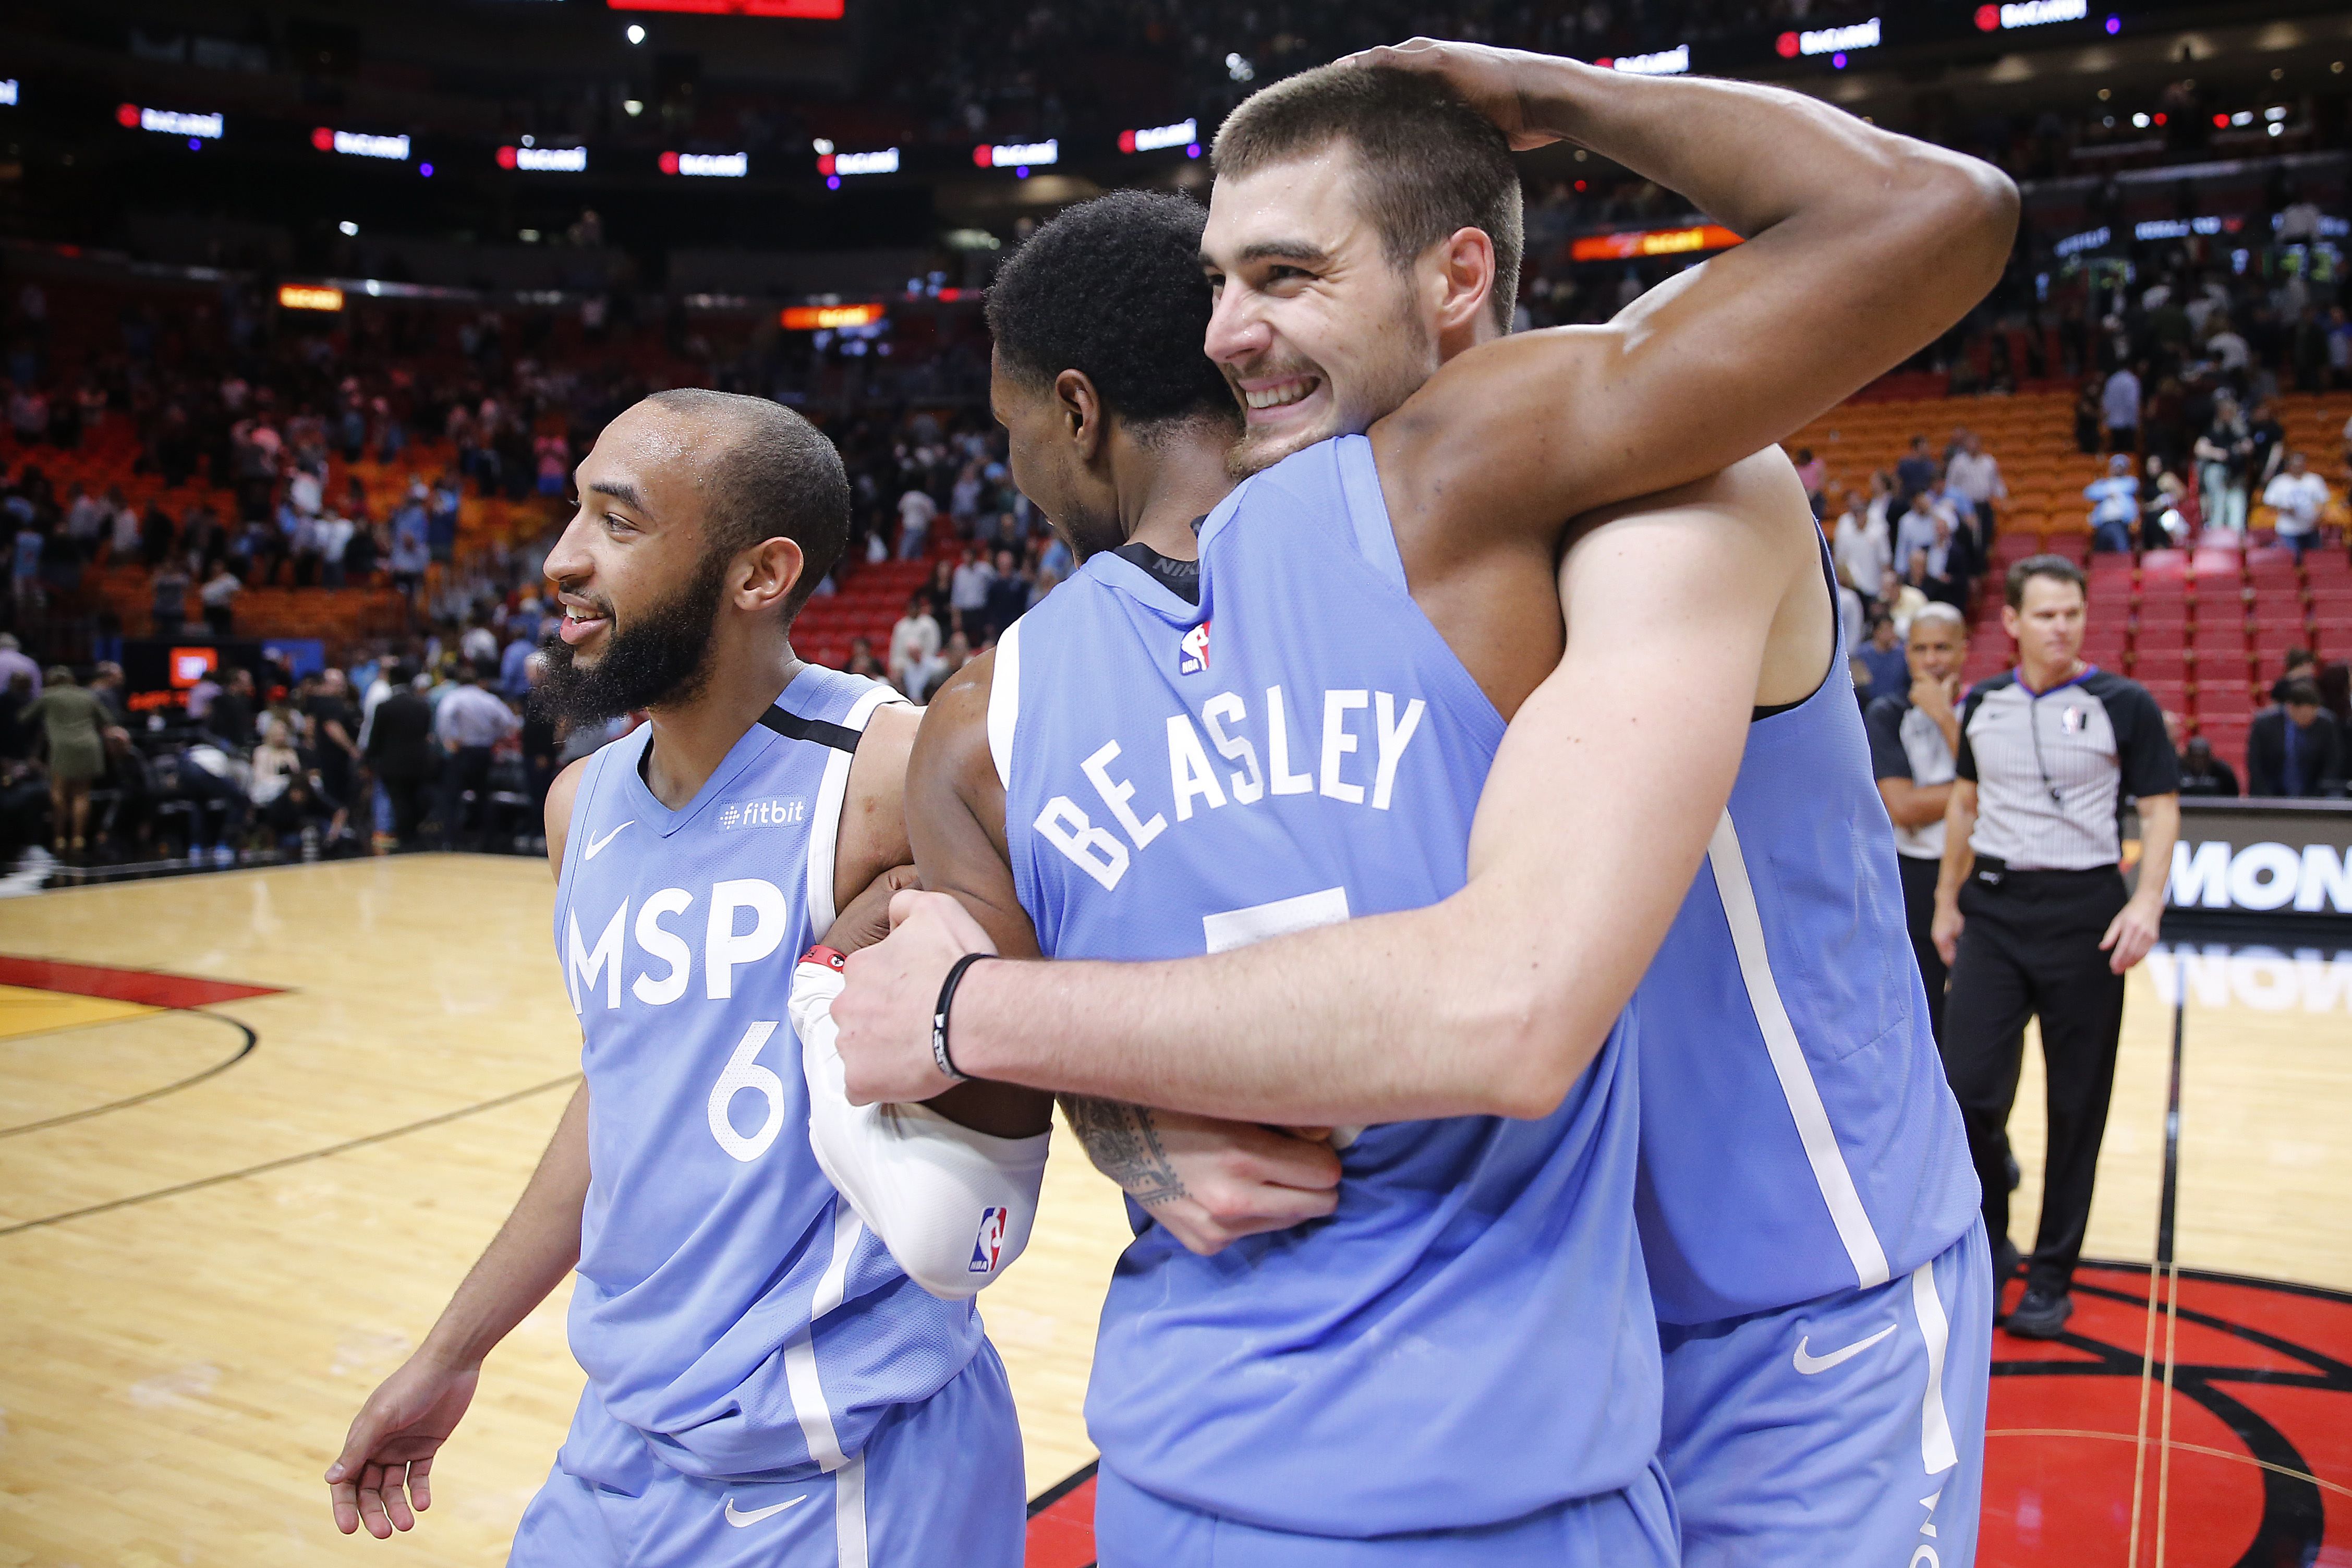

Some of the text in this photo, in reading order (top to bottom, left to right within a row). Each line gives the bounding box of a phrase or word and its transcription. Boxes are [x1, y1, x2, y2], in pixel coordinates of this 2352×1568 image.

[1152, 557, 1198, 577] NIK
[1182, 658, 1199, 674] NBA
[743, 800, 804, 825] fitbit
[1033, 685, 1426, 891] BEASLEY
[568, 879, 787, 1015] MSP
[707, 1020, 785, 1163] 6
